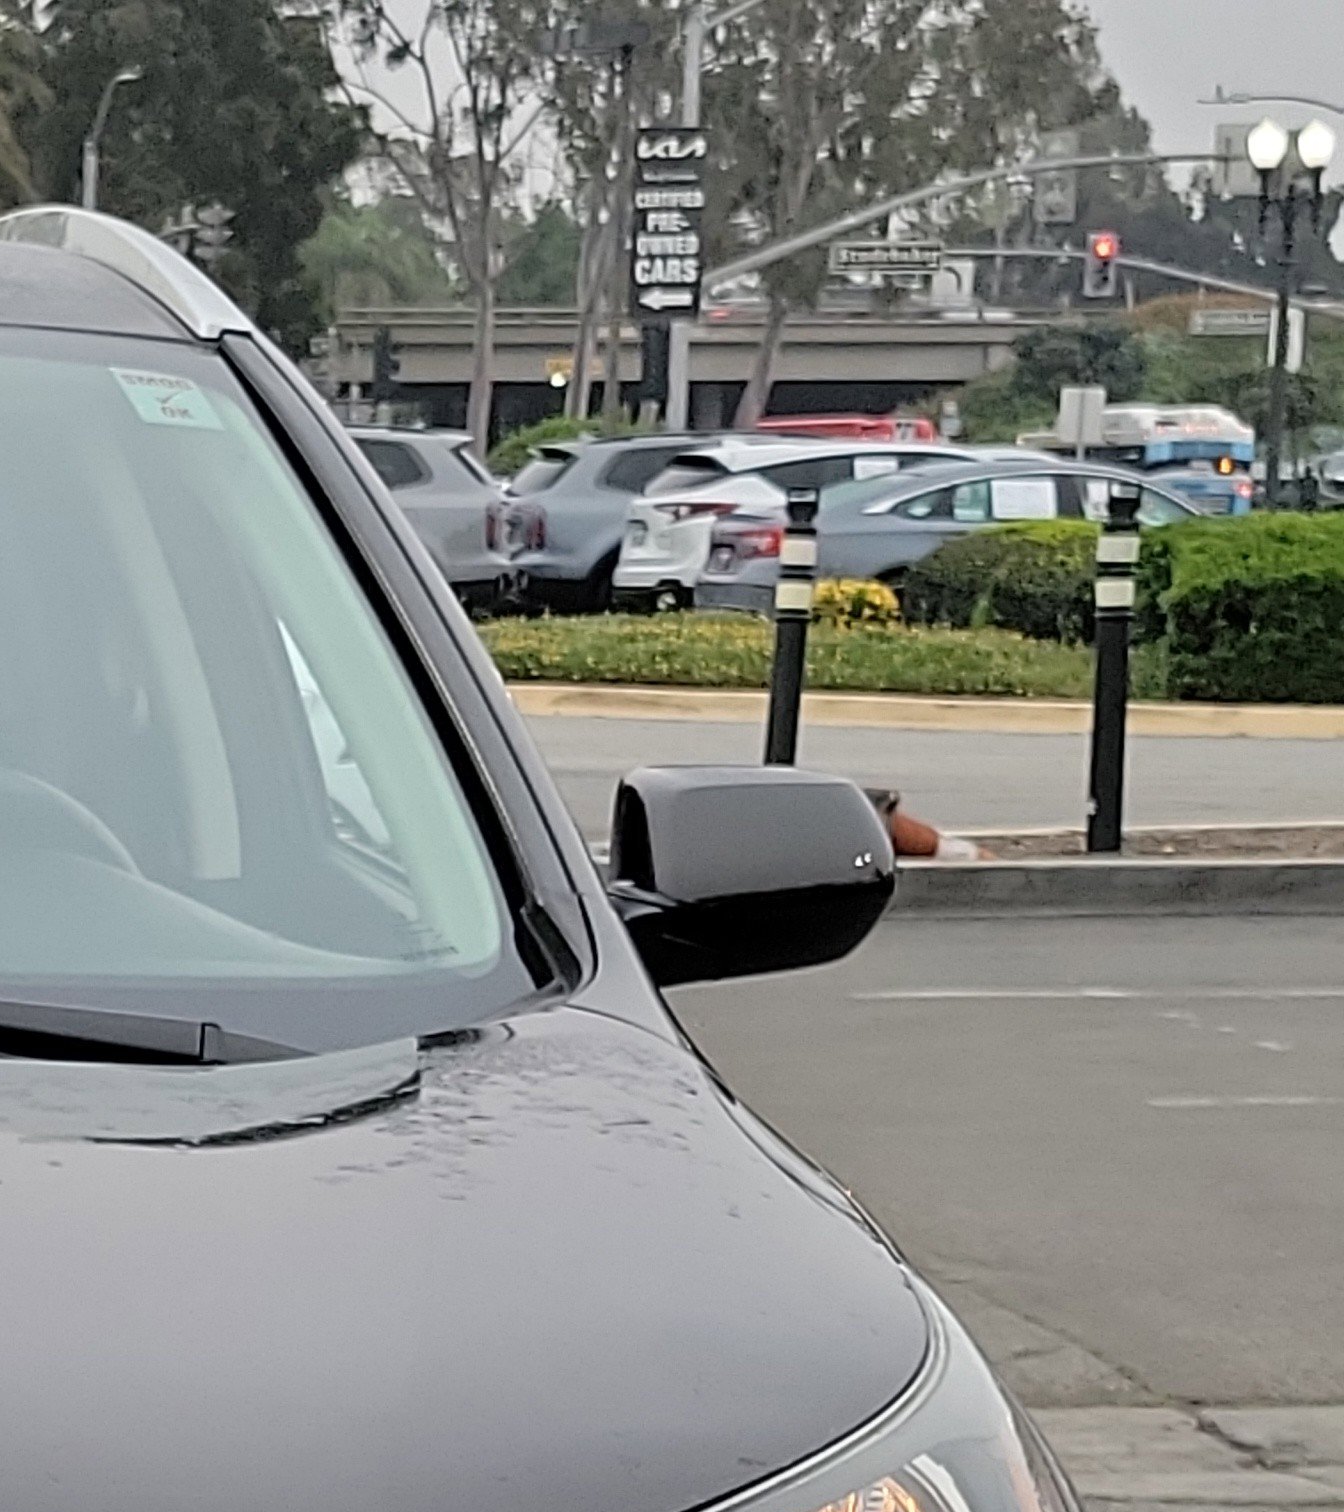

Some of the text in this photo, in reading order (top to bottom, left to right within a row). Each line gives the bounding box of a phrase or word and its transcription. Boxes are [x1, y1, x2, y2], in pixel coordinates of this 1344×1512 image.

[636, 234, 700, 257] OWNED
[634, 257, 700, 285] CARS
[160, 405, 194, 419] OK
